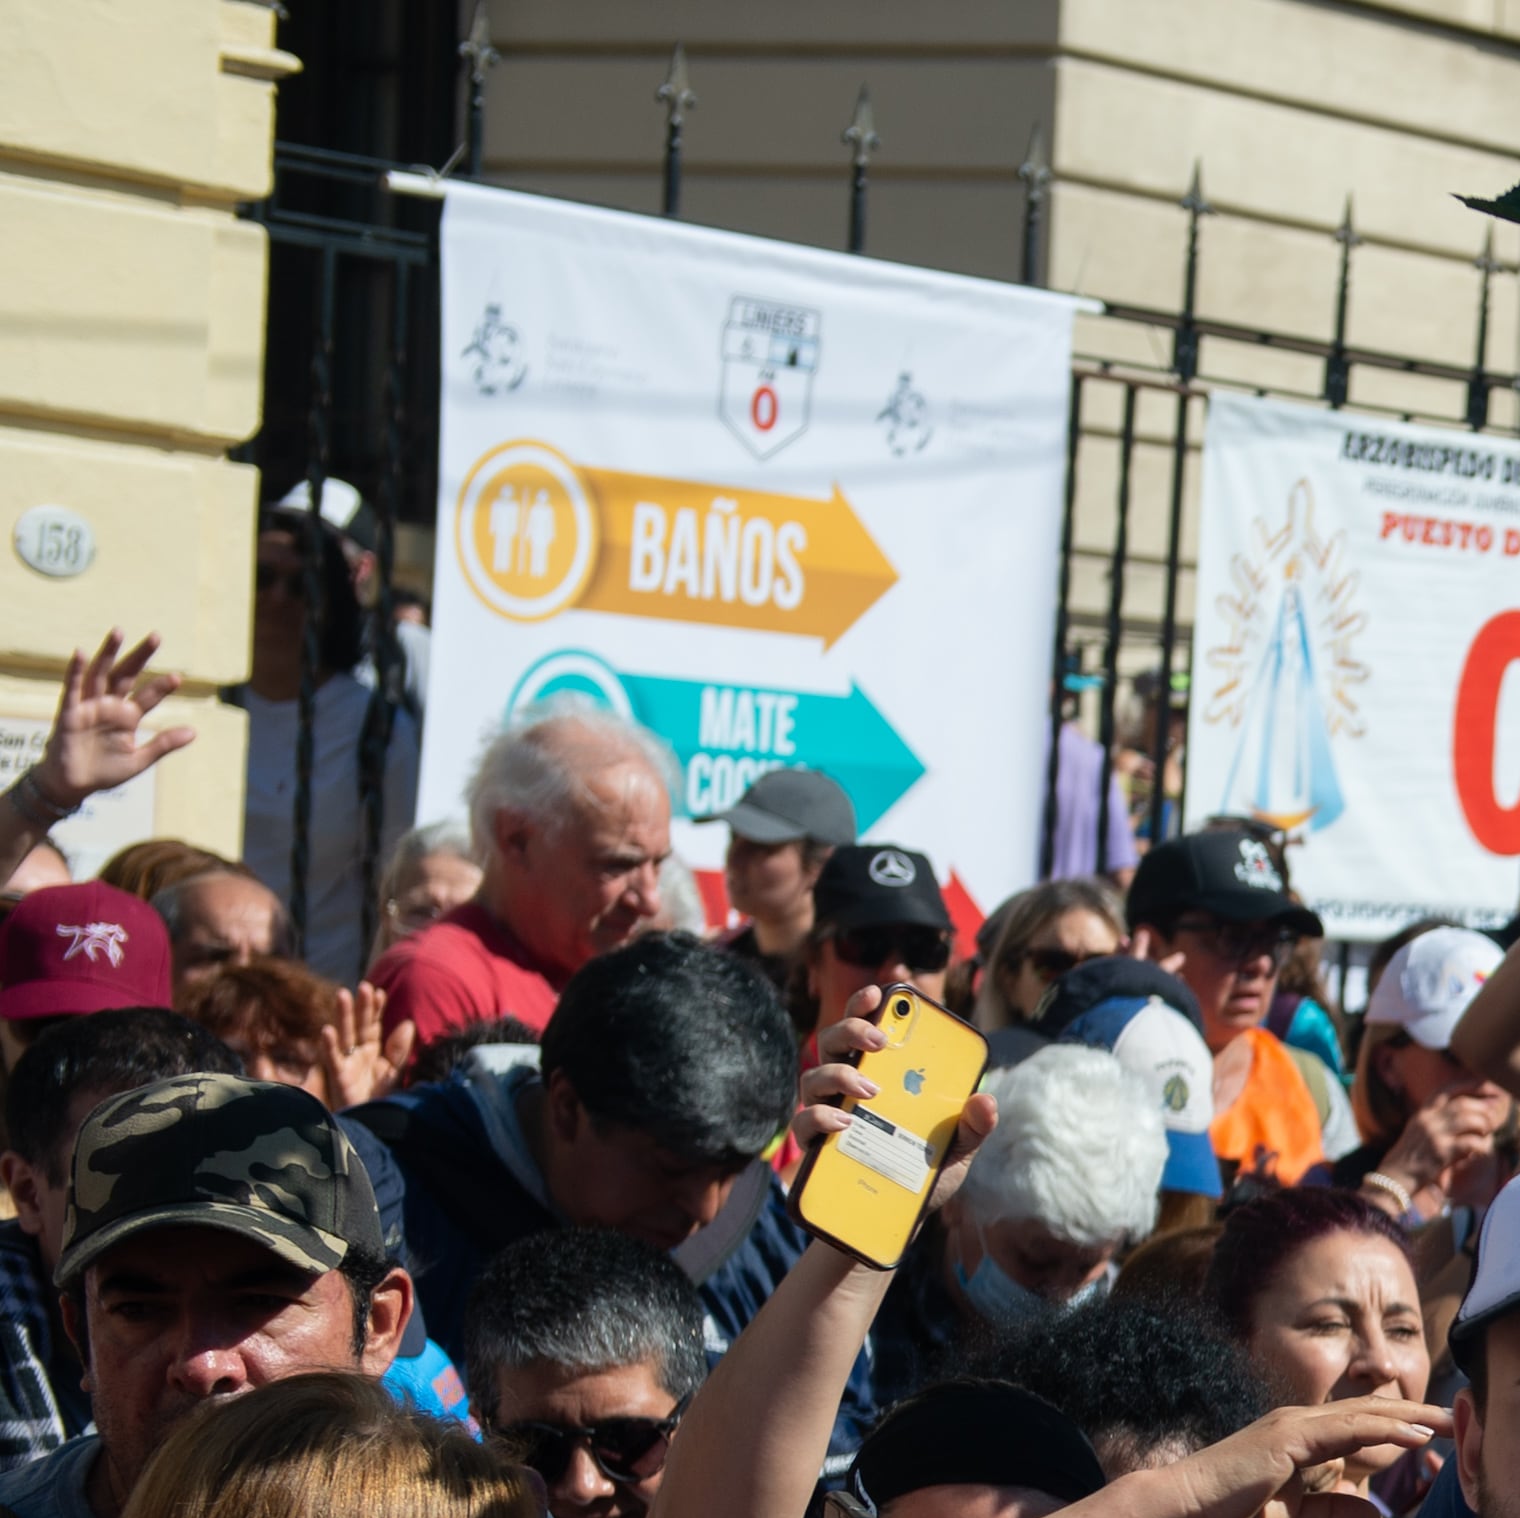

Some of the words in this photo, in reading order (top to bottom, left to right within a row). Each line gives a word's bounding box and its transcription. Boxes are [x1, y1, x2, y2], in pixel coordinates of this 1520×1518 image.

[752, 383, 778, 432] 0
[36, 521, 82, 567] 158
[629, 497, 807, 612] BAÑOS
[1380, 511, 1493, 552] PUESTO
[700, 686, 799, 757] MATE
